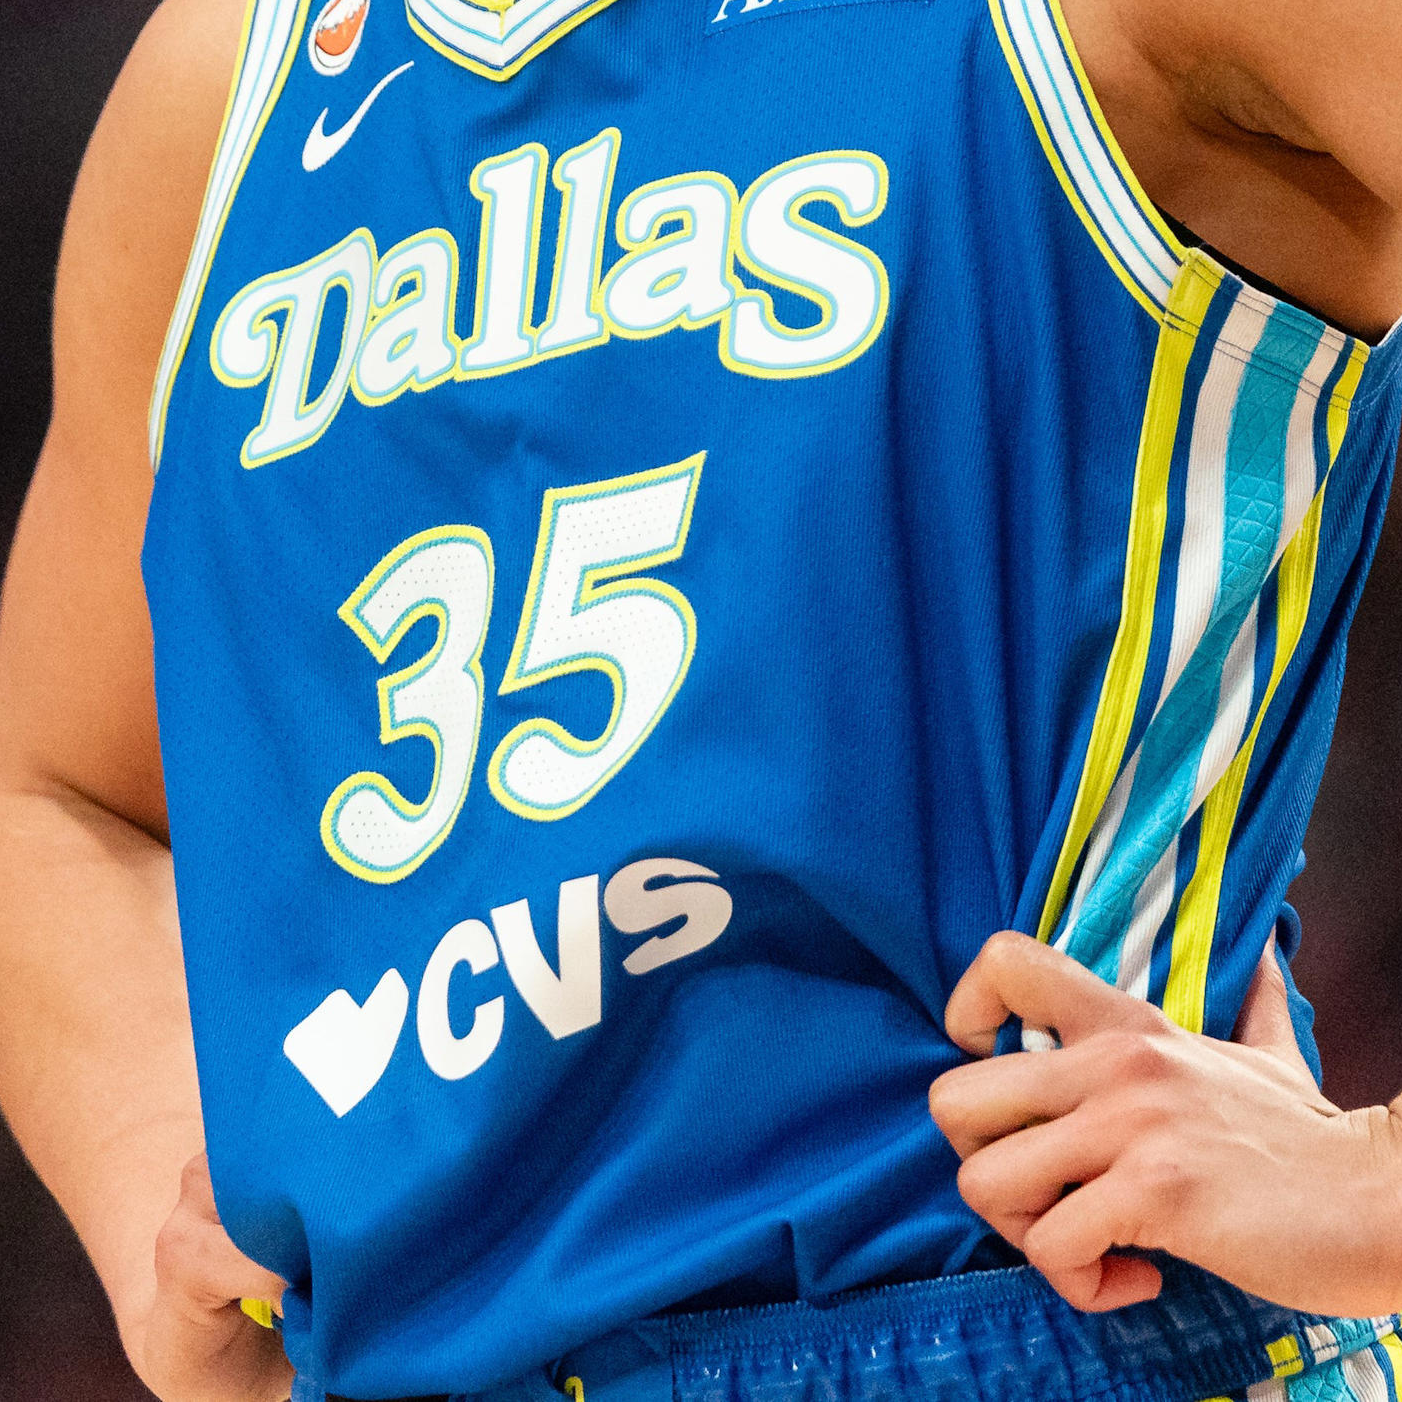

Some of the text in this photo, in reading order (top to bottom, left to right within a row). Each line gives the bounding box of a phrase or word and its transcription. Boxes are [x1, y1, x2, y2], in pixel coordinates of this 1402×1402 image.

[210, 127, 889, 469] Dallas
[320, 450, 706, 884] 35
[417, 857, 733, 1080] CVS
